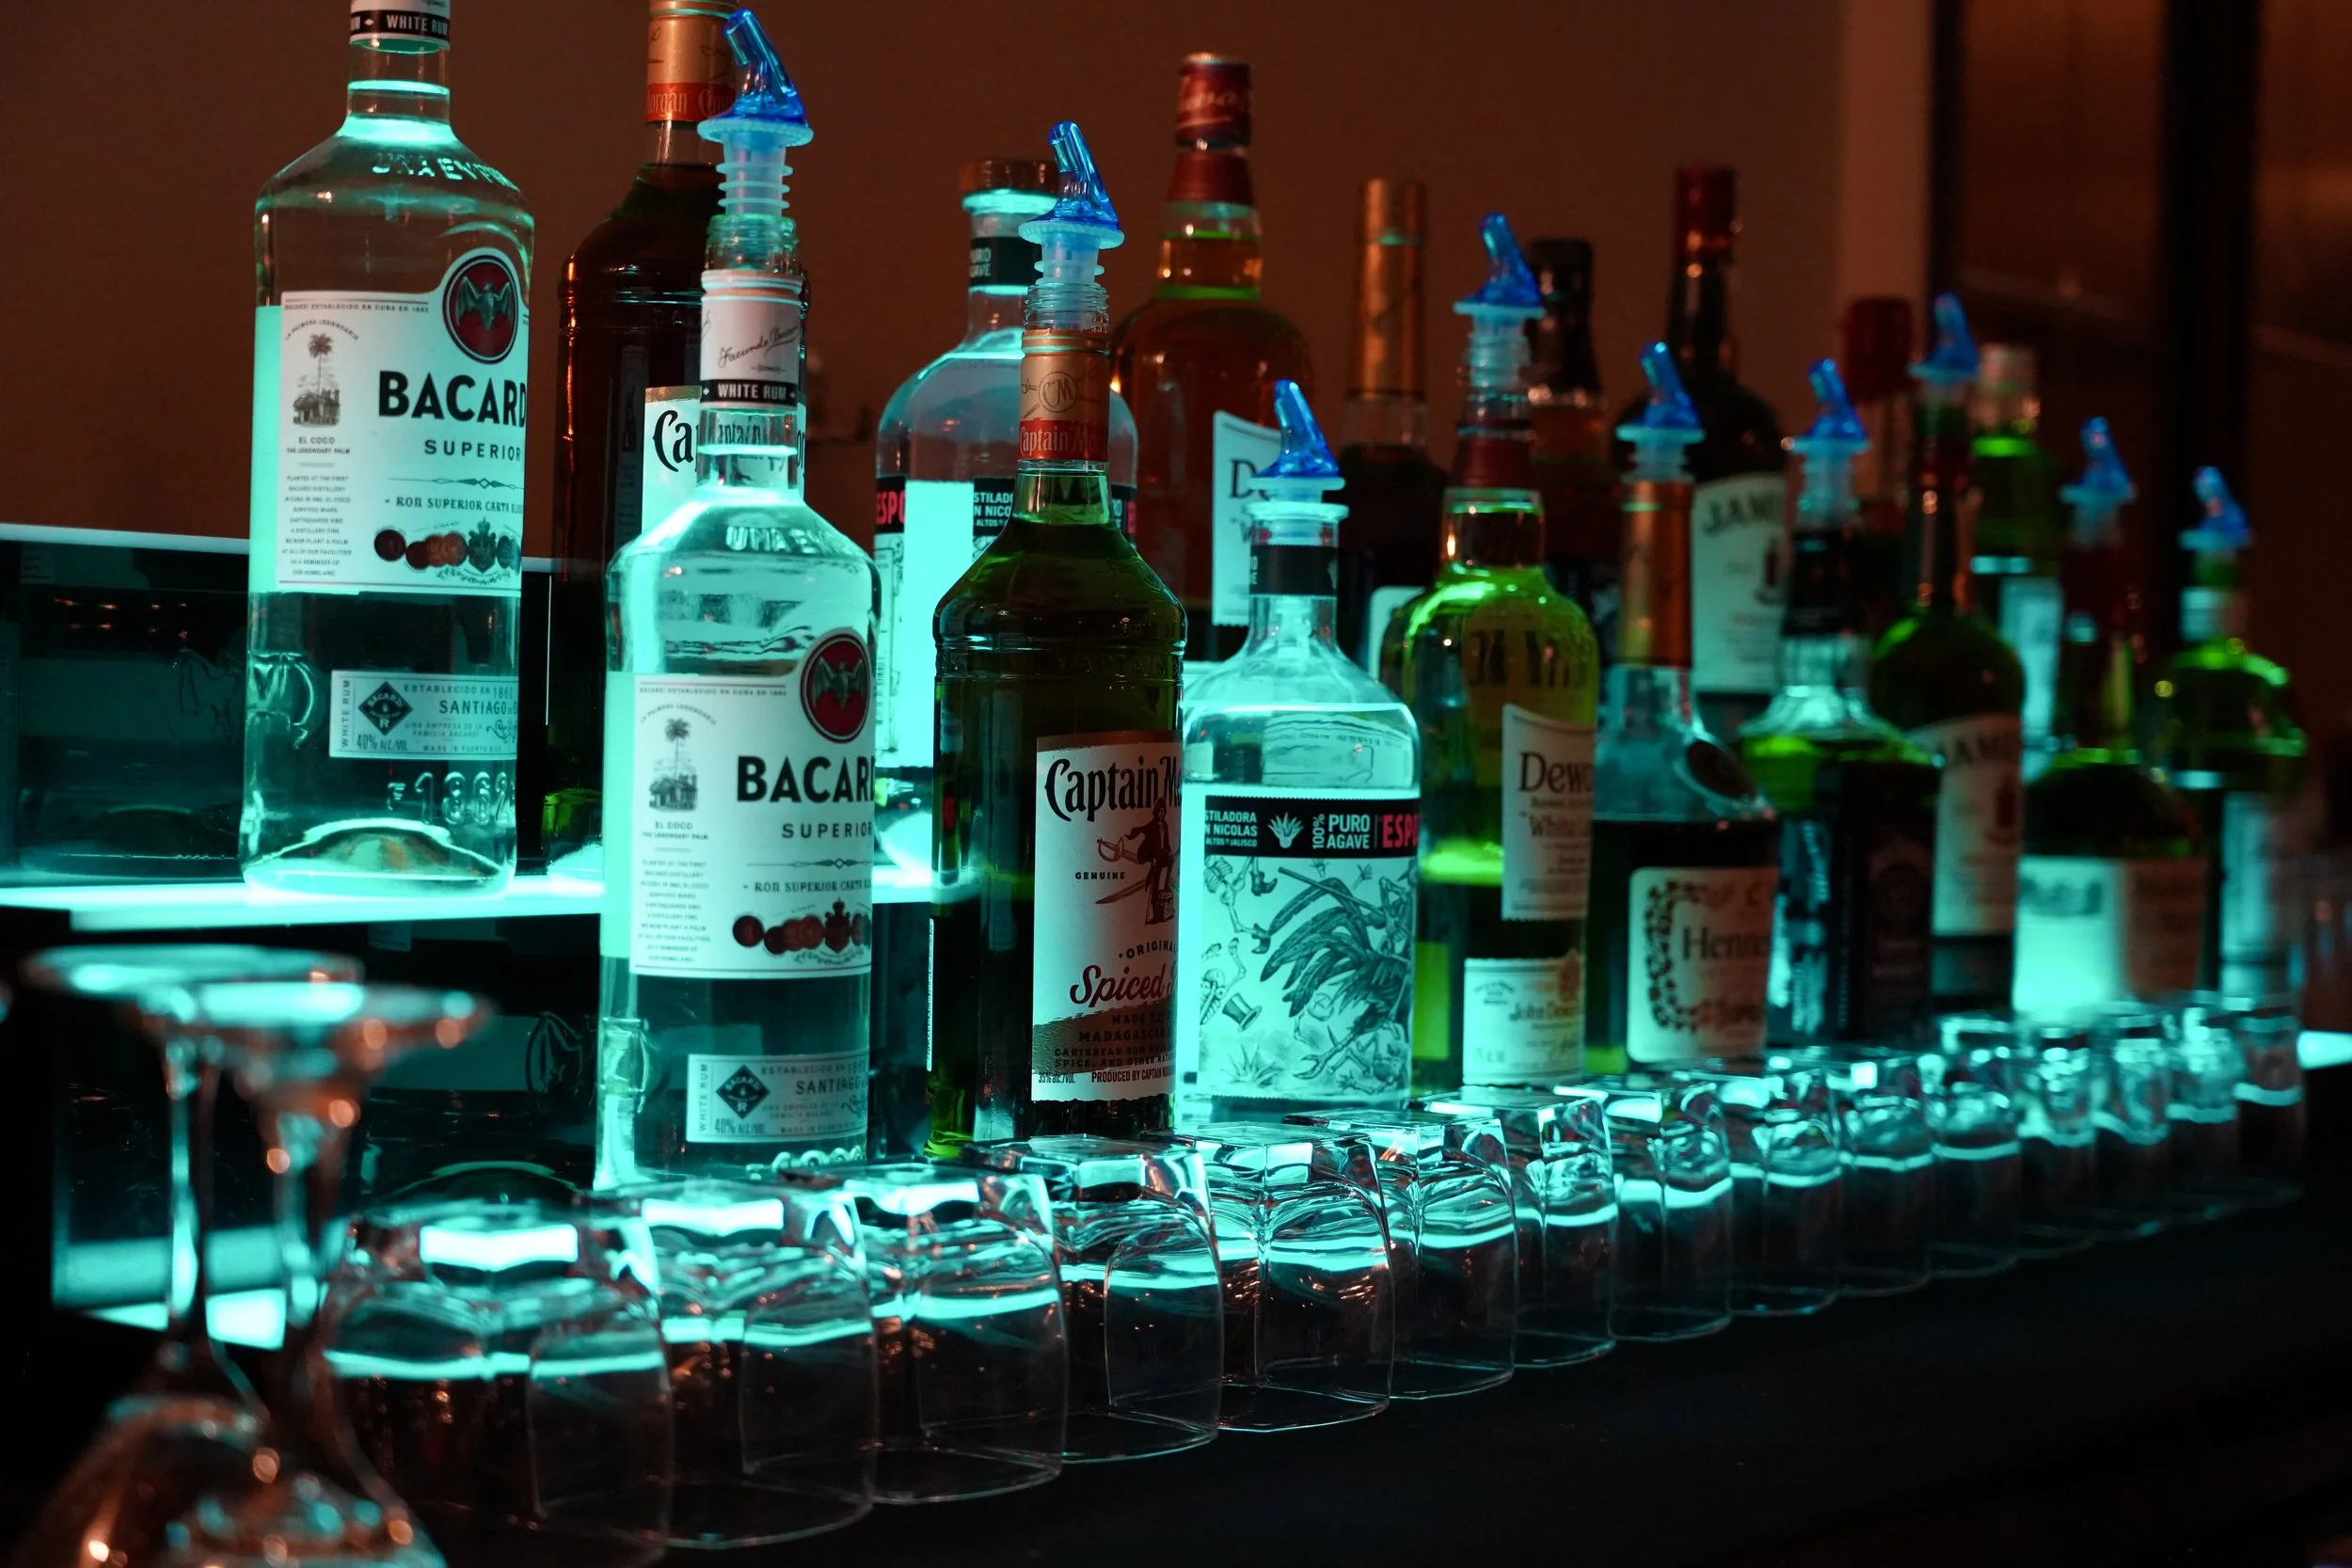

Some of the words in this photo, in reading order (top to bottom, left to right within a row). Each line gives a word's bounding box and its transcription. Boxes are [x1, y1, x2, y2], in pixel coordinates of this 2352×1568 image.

[350, 16, 360, 31] UM
[387, 14, 428, 32] WHITE
[432, 19, 448, 36] RUM
[647, 87, 688, 115] organ
[718, 383, 760, 400] WHITE
[763, 384, 787, 401] RUM
[298, 436, 308, 445] EL
[310, 436, 336, 445] COCO
[653, 409, 699, 473] Ca
[1019, 425, 1070, 457] Captain
[424, 439, 521, 462] SUPERIOR
[427, 497, 482, 511] SUPERIOR
[485, 500, 510, 514] CARTA
[342, 679, 351, 705] RUM
[404, 685, 477, 694] ESTABLECIDO
[481, 687, 491, 695] EN
[493, 687, 514, 700] 1862
[439, 700, 507, 716] SANTIAGO
[341, 709, 349, 749] WHITE
[357, 734, 378, 752] 40%
[1044, 755, 1158, 822] Captain
[655, 821, 663, 830] EL
[667, 821, 693, 831] COCO
[782, 821, 872, 839] SUPERIOR
[1213, 825, 1258, 837] NICOLAS
[1312, 814, 1325, 849] 100%
[1328, 815, 1370, 832] PURO
[1327, 834, 1370, 849] AGAVE
[1074, 871, 1126, 880] GENUINE
[755, 881, 780, 893] RON
[785, 880, 837, 894] SUPERIOR
[1069, 963, 1167, 1008] Spiced
[1112, 1013, 1146, 1026] MADE
[1079, 1027, 1165, 1042] MADAGASCAR
[1054, 1046, 1122, 1058] CARIBBEAN
[1126, 1044, 1146, 1055] RUM
[1101, 1057, 1123, 1068] AND
[1128, 1055, 1154, 1066] OTHER
[700, 1063, 709, 1089] RUM
[761, 1065, 833, 1076] ESTABLECIDO
[1091, 1069, 1130, 1084] PRODUCED
[1132, 1069, 1140, 1082] BY
[1141, 1067, 1162, 1081] CAPTAIN
[796, 1076, 861, 1096] SANTIAGO
[698, 1094, 707, 1132] WHITE
[714, 1117, 736, 1134] 40%
